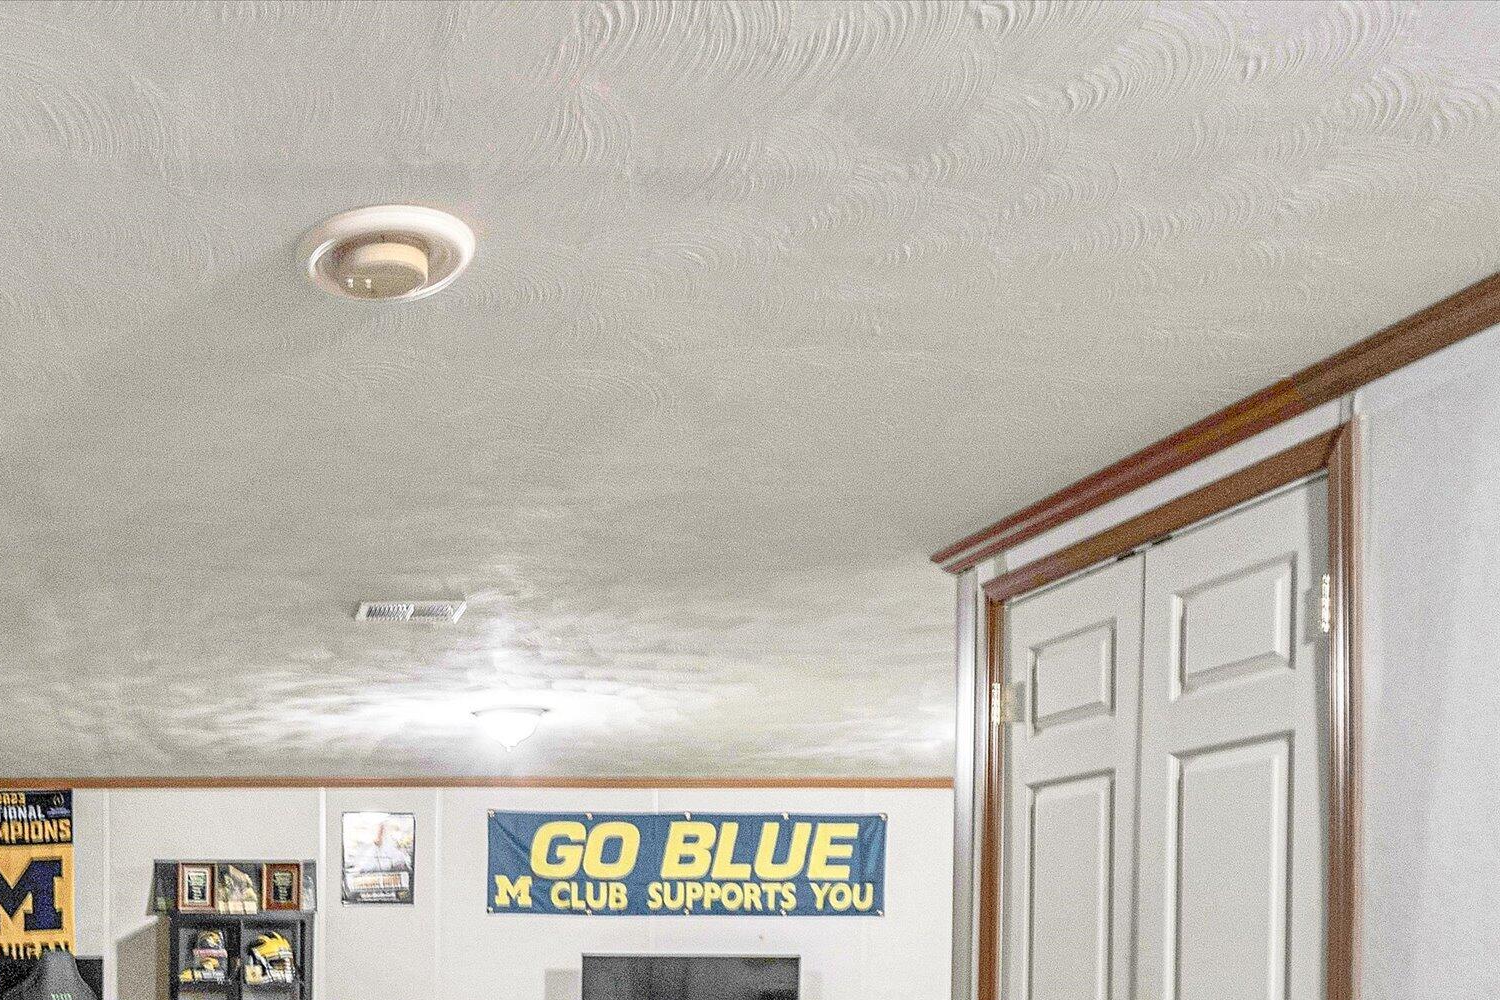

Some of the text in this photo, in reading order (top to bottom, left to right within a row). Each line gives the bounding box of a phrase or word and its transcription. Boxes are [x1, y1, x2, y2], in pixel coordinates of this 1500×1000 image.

[531, 821, 859, 880] GO BLUE
[494, 874, 873, 911] M CLUB SUPPORTS YOU
